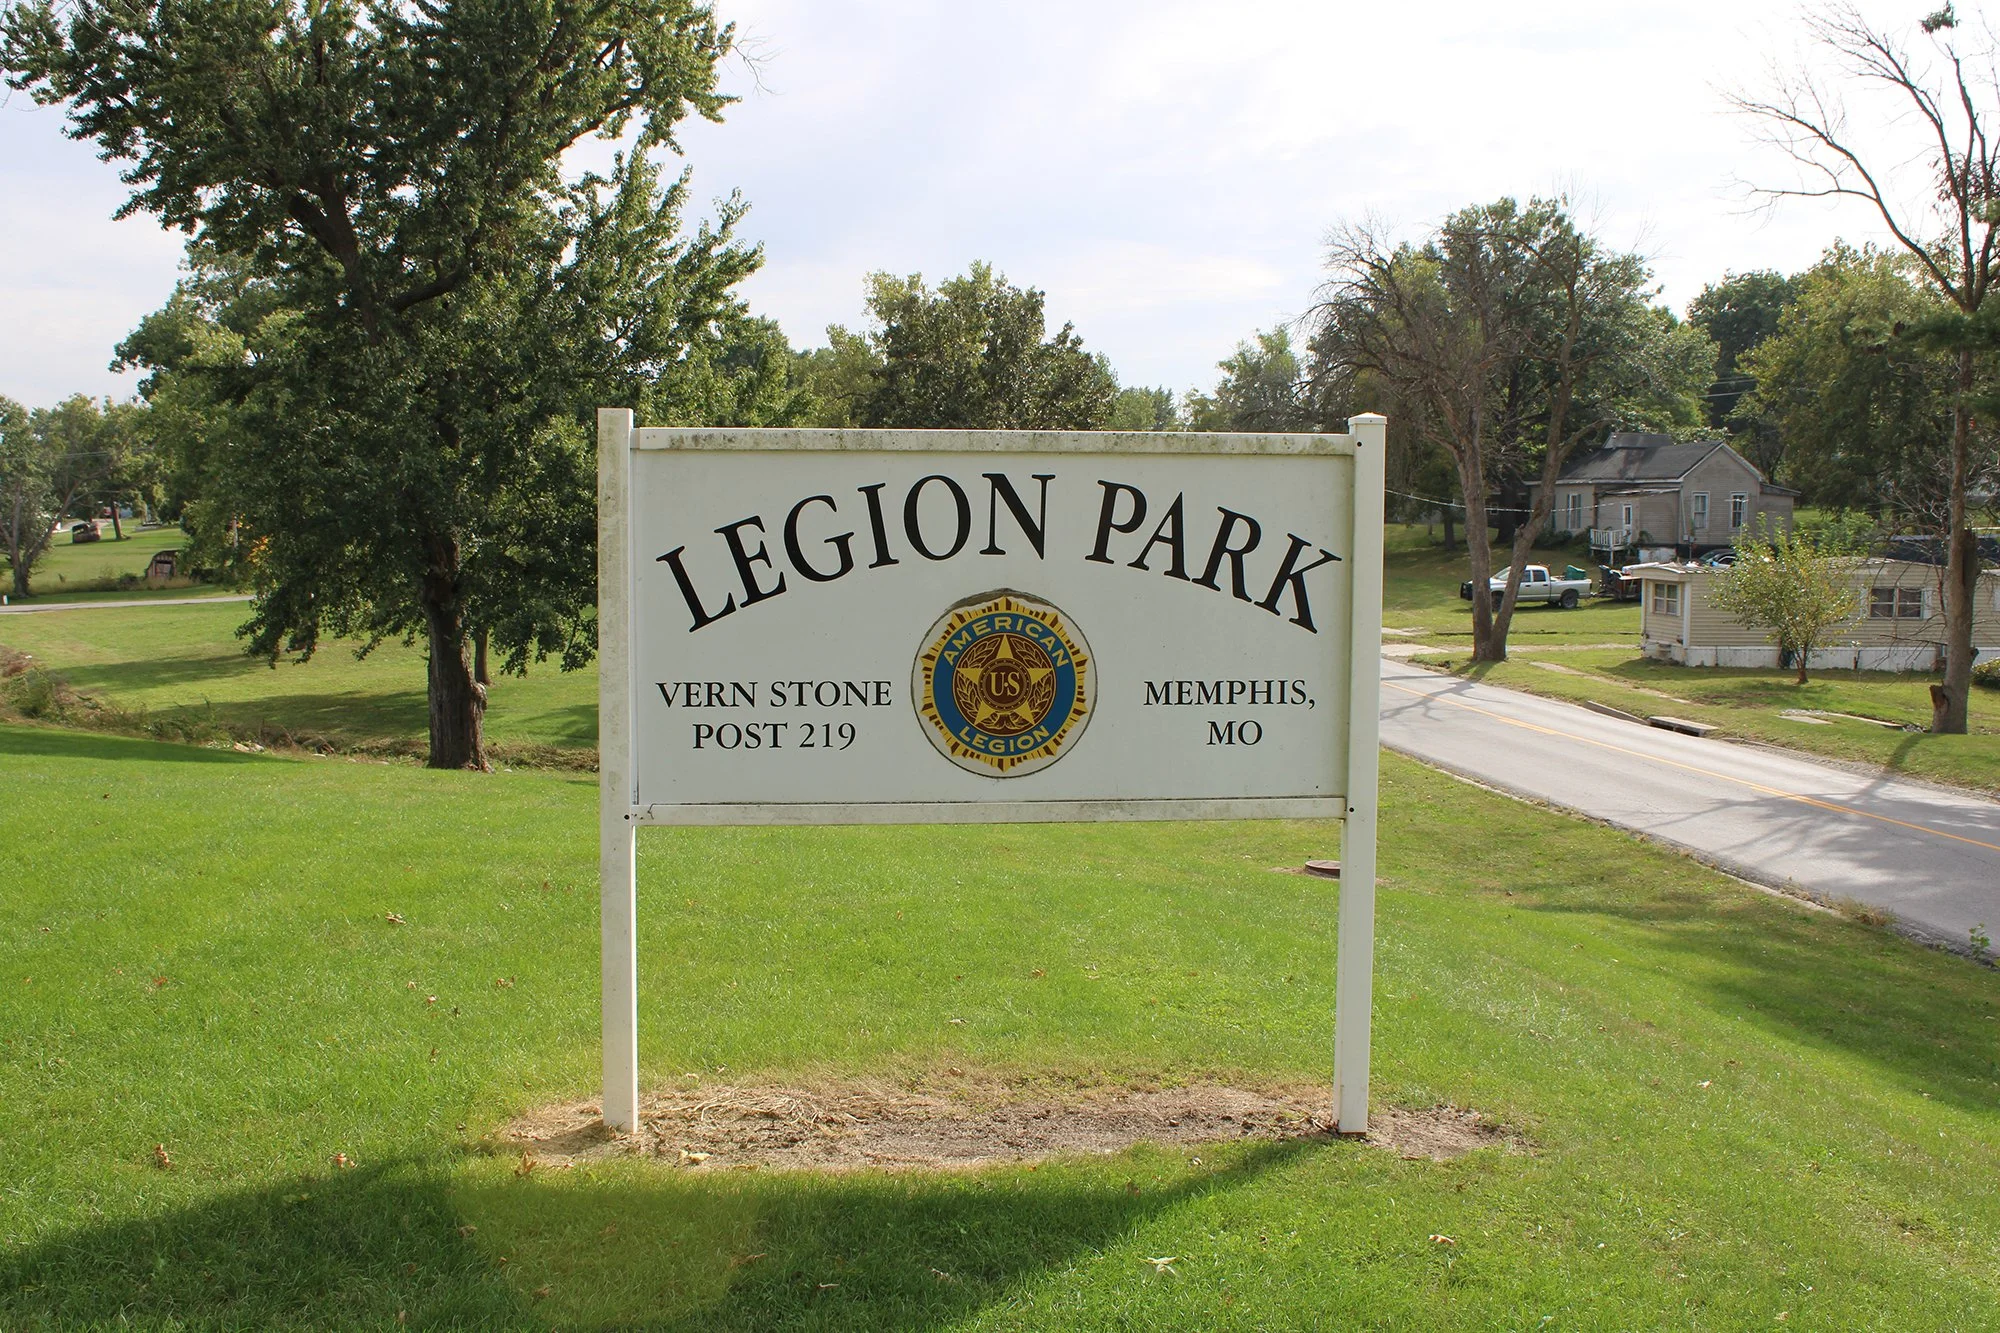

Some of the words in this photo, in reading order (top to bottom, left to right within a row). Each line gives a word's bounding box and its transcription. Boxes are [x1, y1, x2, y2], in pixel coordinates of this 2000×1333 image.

[655, 472, 1057, 633] LEGION
[1085, 479, 1343, 635] PARK
[942, 616, 1069, 668] AMERICAN
[655, 681, 760, 708] VERN
[770, 680, 892, 708] STONE
[1143, 679, 1316, 710] MEMPHIS,
[692, 721, 788, 750] POST
[798, 722, 856, 751] 219
[958, 725, 1050, 754] LEGION
[1206, 720, 1263, 746] MO
